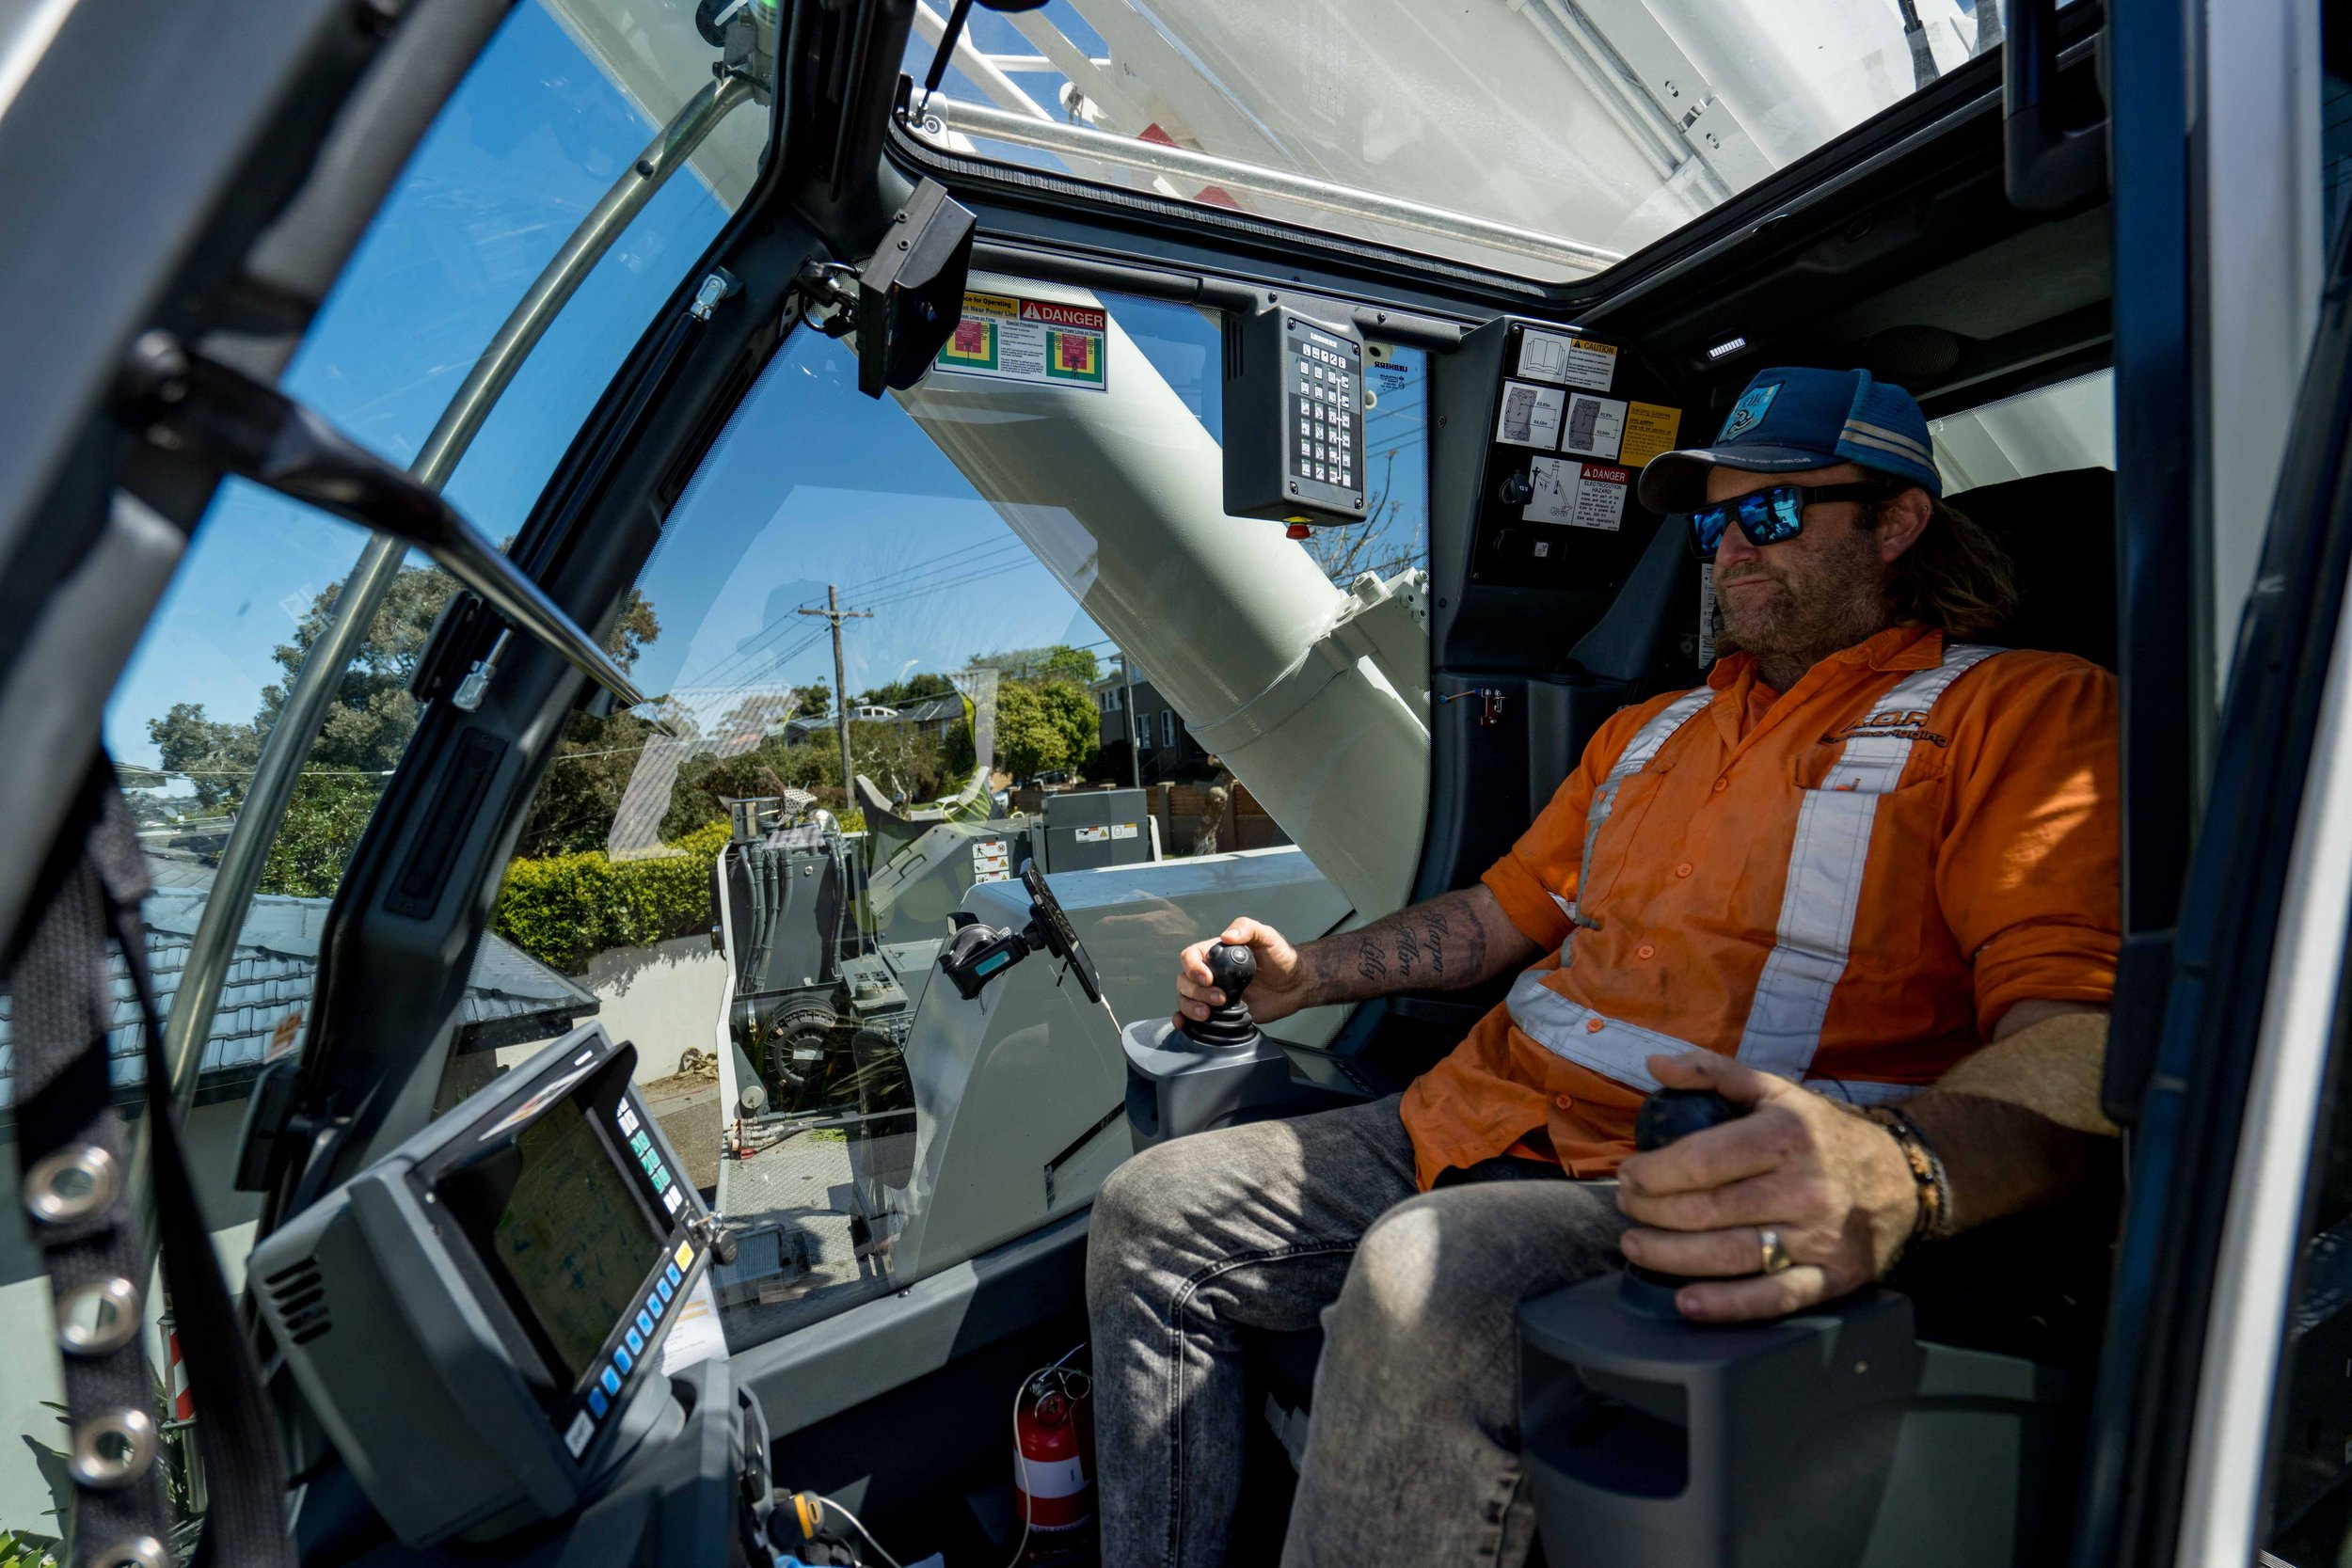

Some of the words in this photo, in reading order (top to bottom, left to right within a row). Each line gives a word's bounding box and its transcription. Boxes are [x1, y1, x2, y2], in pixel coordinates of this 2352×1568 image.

[983, 298, 1011, 309] Operating
[1042, 308, 1103, 327] DANGER
[1311, 333, 1337, 348] LIEBHERR
[1584, 342, 1614, 354] CAUTION
[1593, 468, 1626, 482] DANGER
[1584, 481, 1622, 489] ELECTROCUTION
[1419, 911, 1450, 975] Harper
[1358, 935, 1387, 981] Lilly
